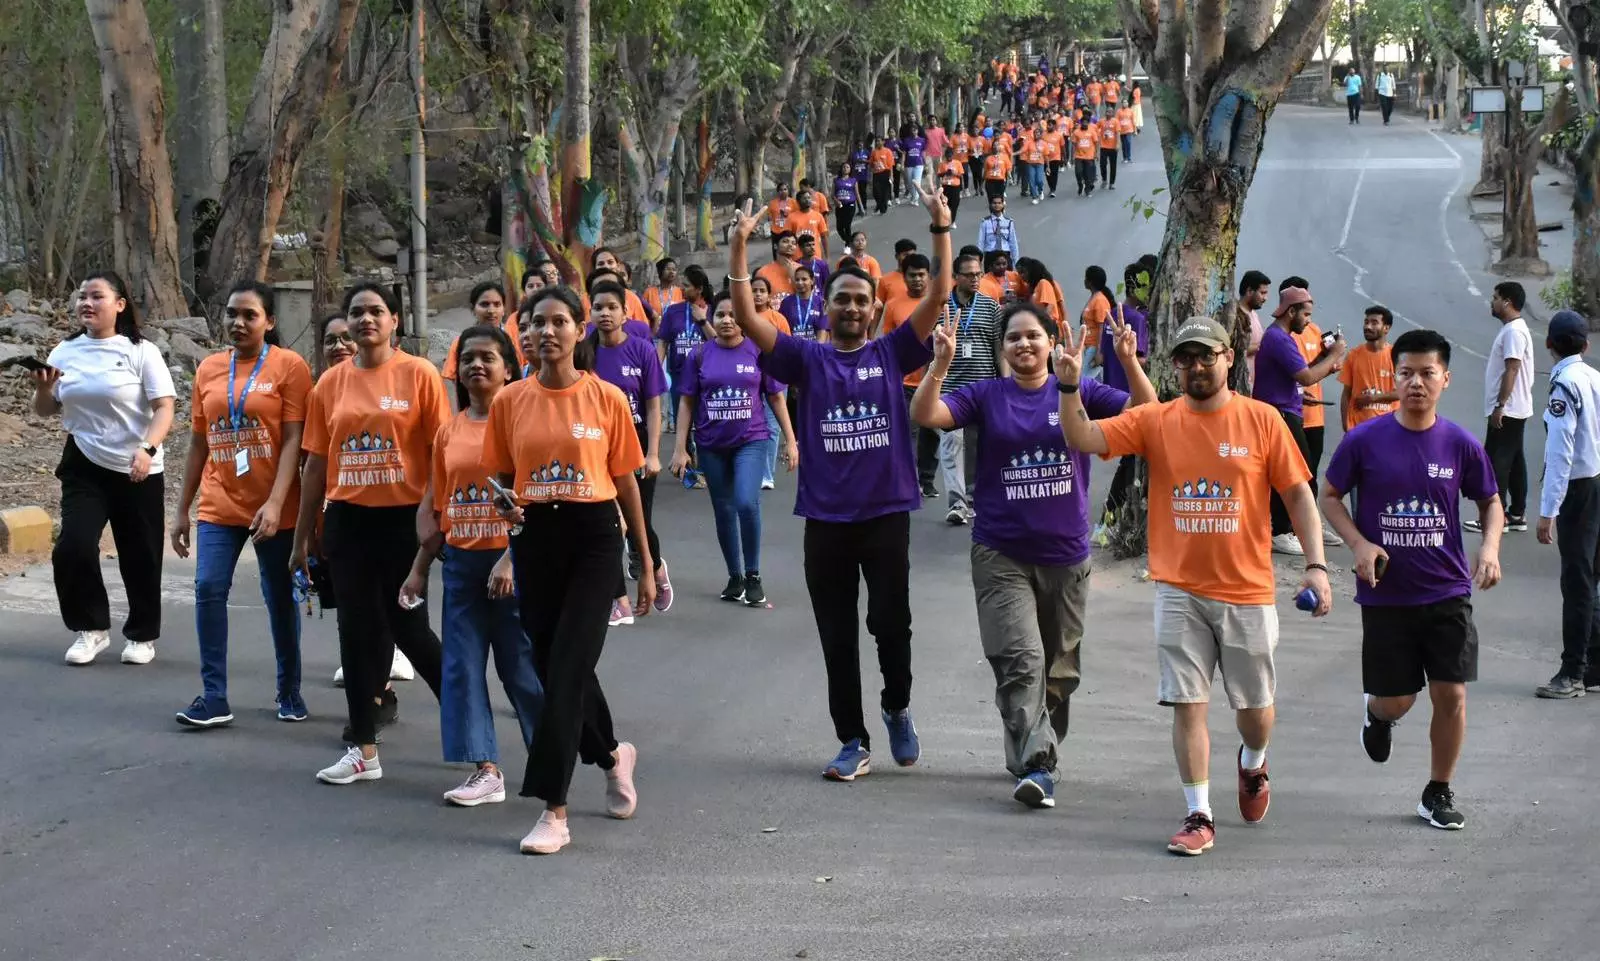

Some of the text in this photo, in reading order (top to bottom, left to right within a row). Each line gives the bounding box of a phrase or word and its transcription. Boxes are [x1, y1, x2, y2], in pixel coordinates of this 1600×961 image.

[868, 366, 883, 374] AIG
[707, 408, 752, 420] WALKATHON
[822, 416, 887, 433] NURSES DAY '24
[823, 432, 890, 452] WALKATHON
[1230, 446, 1248, 454] AIG
[371, 452, 388, 464] DAY
[338, 468, 405, 486] WALKATHON
[1004, 464, 1072, 481] NURSES DAY '24
[1439, 468, 1454, 476] AIG
[577, 486, 593, 497] '24
[1006, 480, 1072, 500] WALKATHON
[474, 506, 491, 518] DAY
[1205, 501, 1224, 512] DAY
[1224, 501, 1240, 512] '24
[1174, 517, 1240, 534] WALKATHON
[1381, 516, 1416, 528] NURSES
[1418, 518, 1434, 528] DAY
[1382, 530, 1444, 548] WALKATHON
